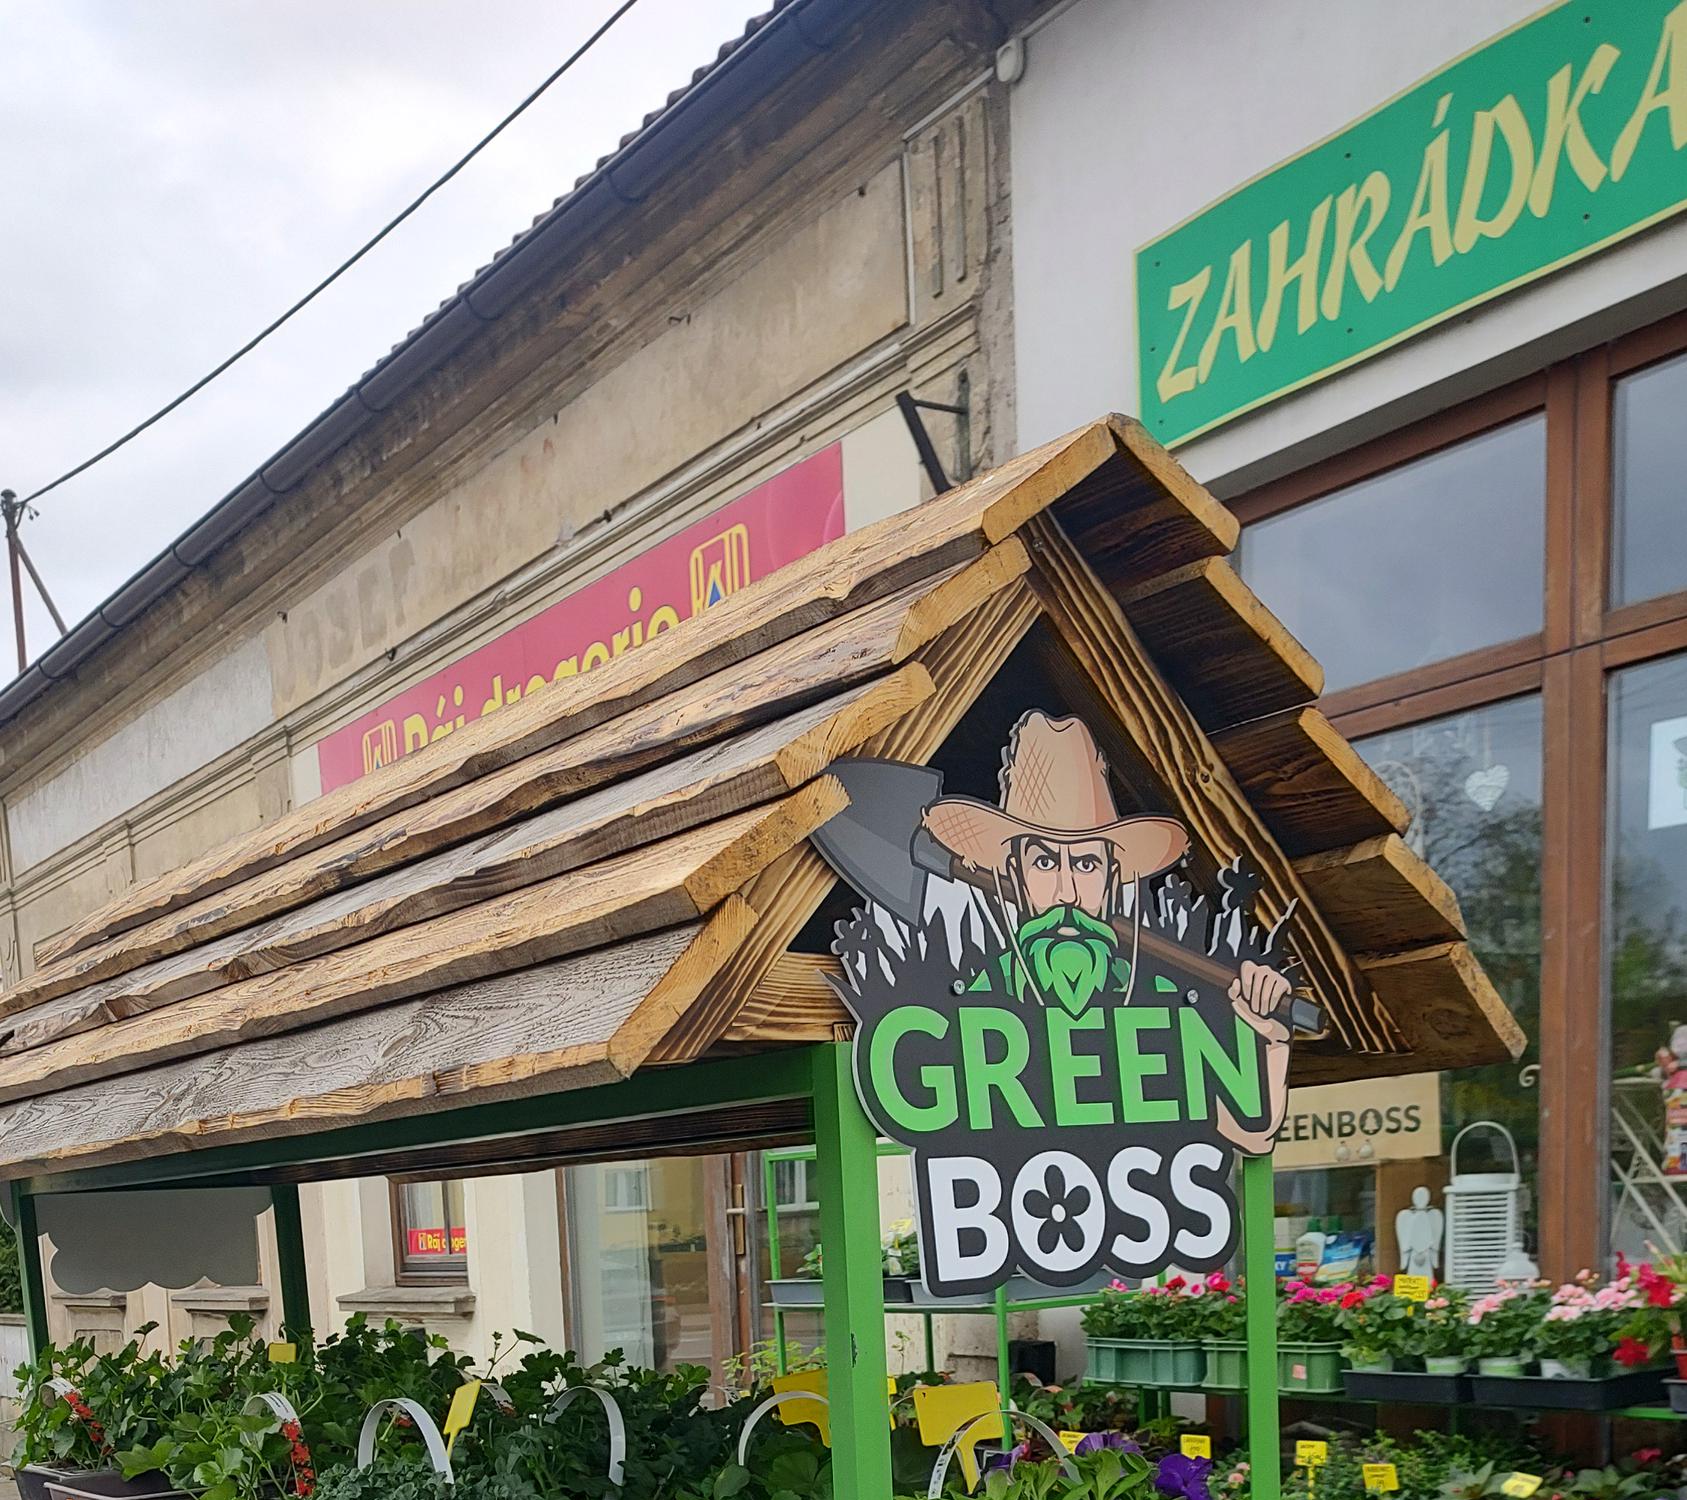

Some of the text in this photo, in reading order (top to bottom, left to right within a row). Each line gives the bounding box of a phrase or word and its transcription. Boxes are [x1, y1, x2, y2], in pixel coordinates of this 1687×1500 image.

[1156, 0, 1687, 403] ZAHRÁDKA
[870, 1005, 1263, 1132] GREEN
[1275, 1105, 1421, 1142] EENBOSS
[927, 1143, 1231, 1282] BOSS
